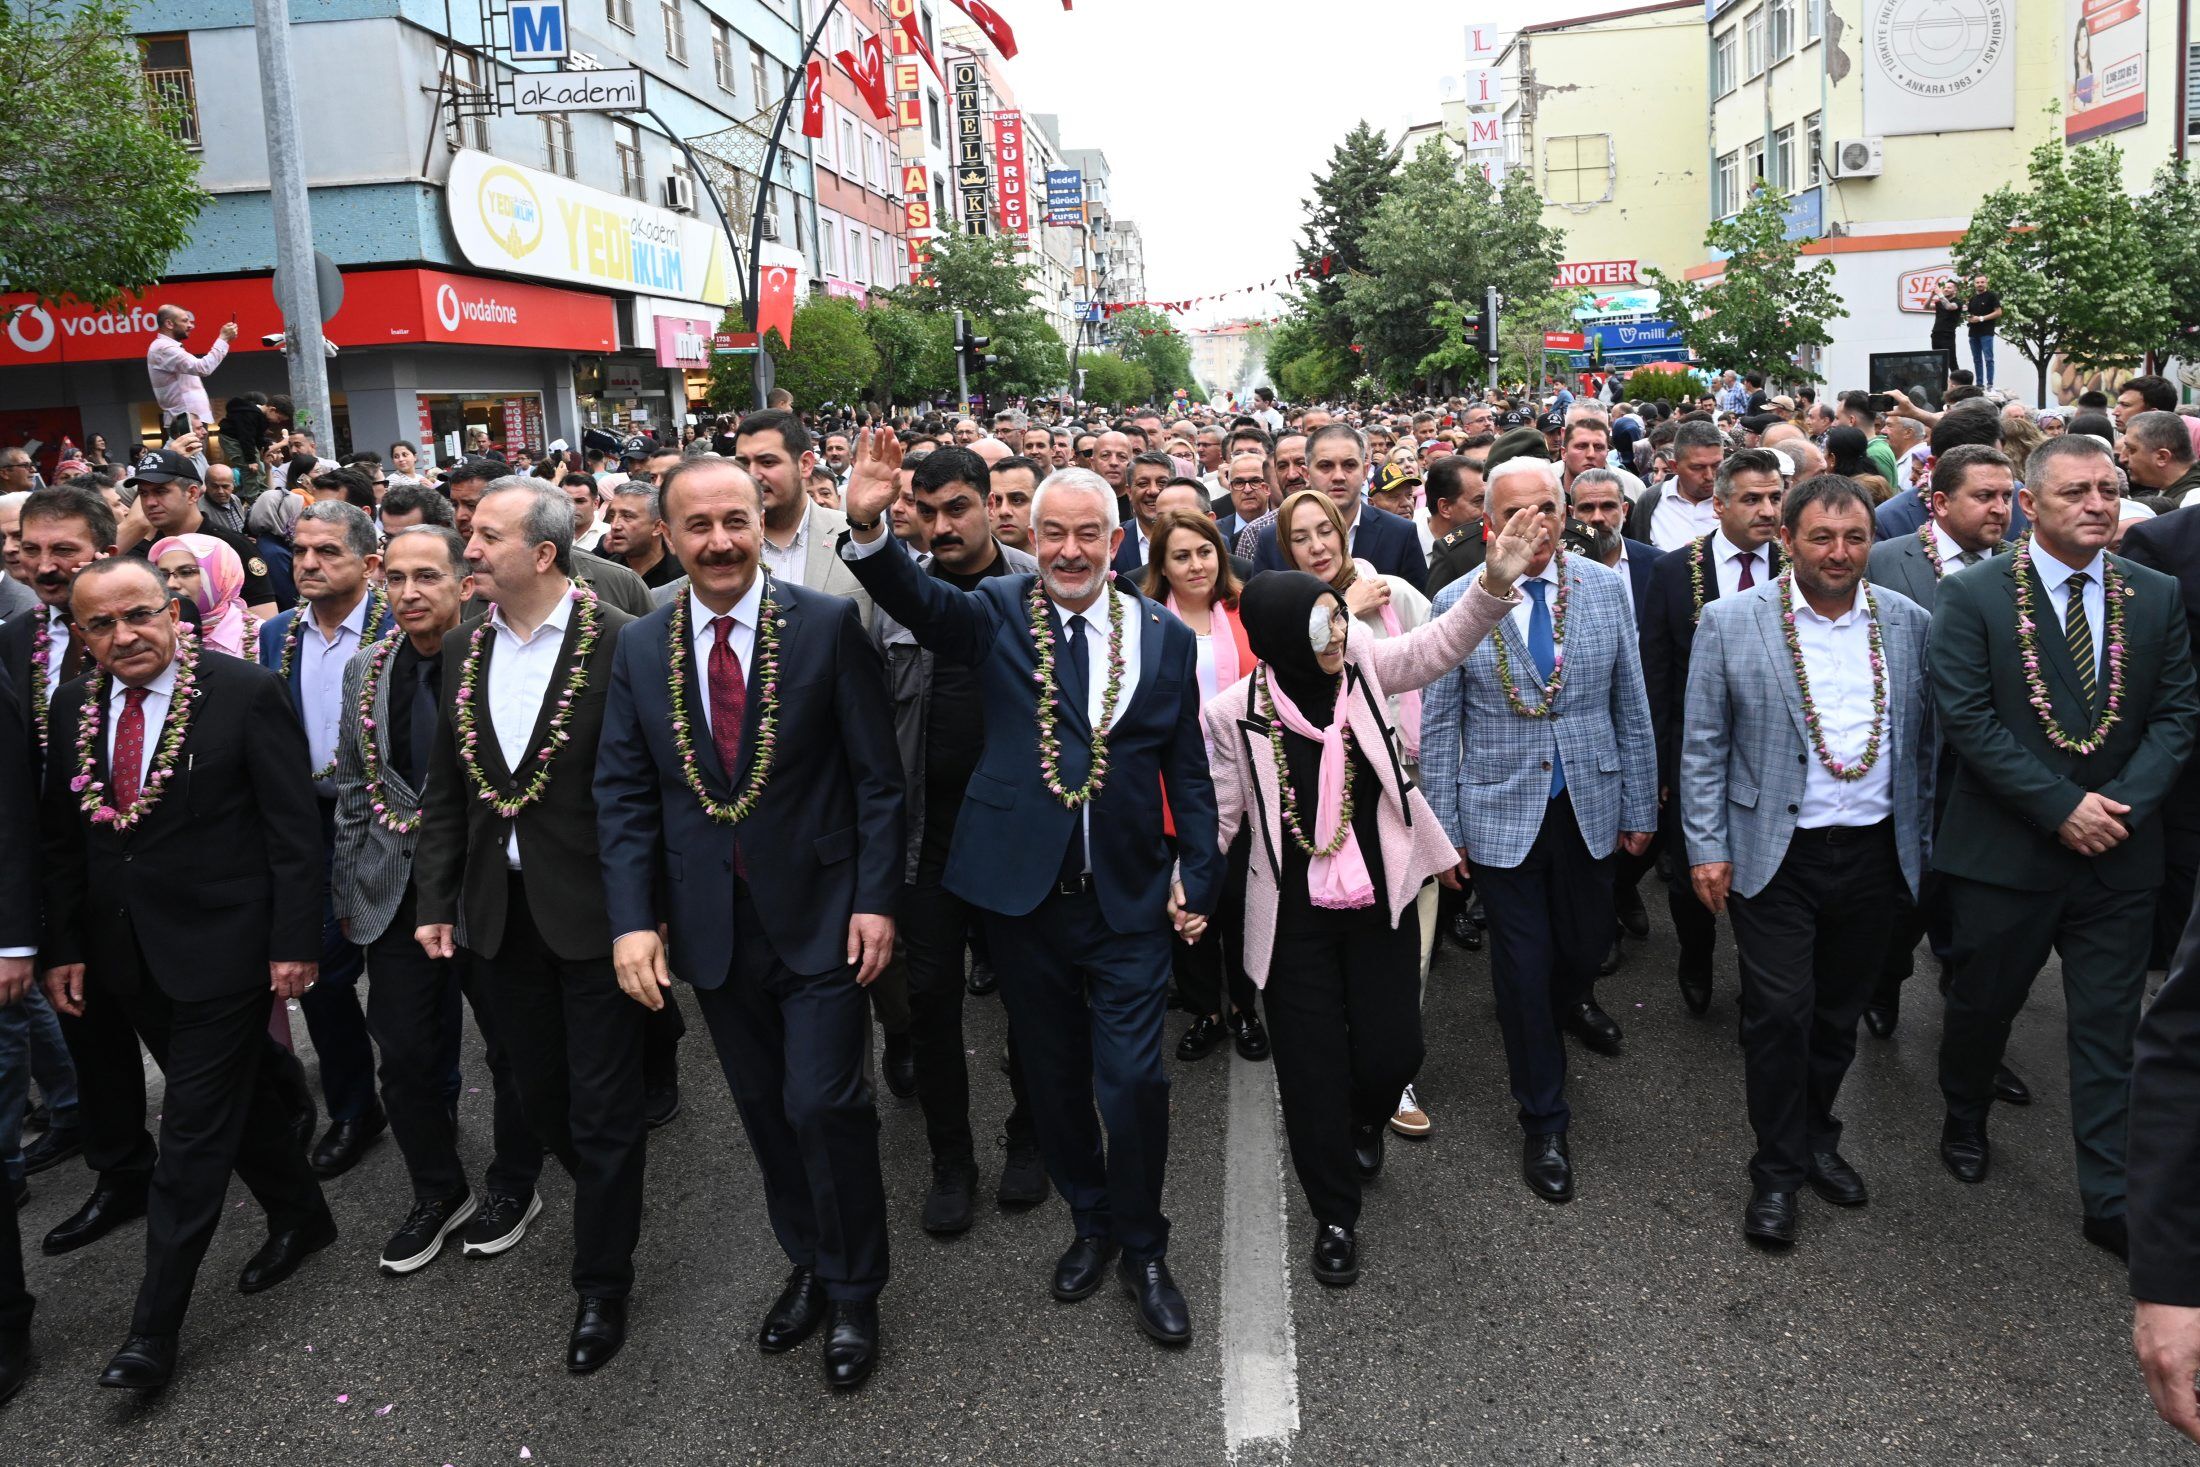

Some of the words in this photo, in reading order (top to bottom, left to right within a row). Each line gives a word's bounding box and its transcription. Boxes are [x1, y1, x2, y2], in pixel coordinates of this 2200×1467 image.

[512, 6, 562, 52] M
[522, 76, 636, 105] akademi
[1905, 79, 1946, 94] ANKARA
[1948, 76, 1972, 92] 1963
[958, 67, 978, 160] OTEL
[1002, 132, 1022, 228] SÜRÜCÜ
[1050, 176, 1077, 184] hedef
[1050, 196, 1080, 205] sürücü
[630, 208, 679, 246] akademi
[1052, 212, 1080, 220] kursu
[461, 298, 517, 324] vodafone
[1639, 328, 1665, 340] milli
